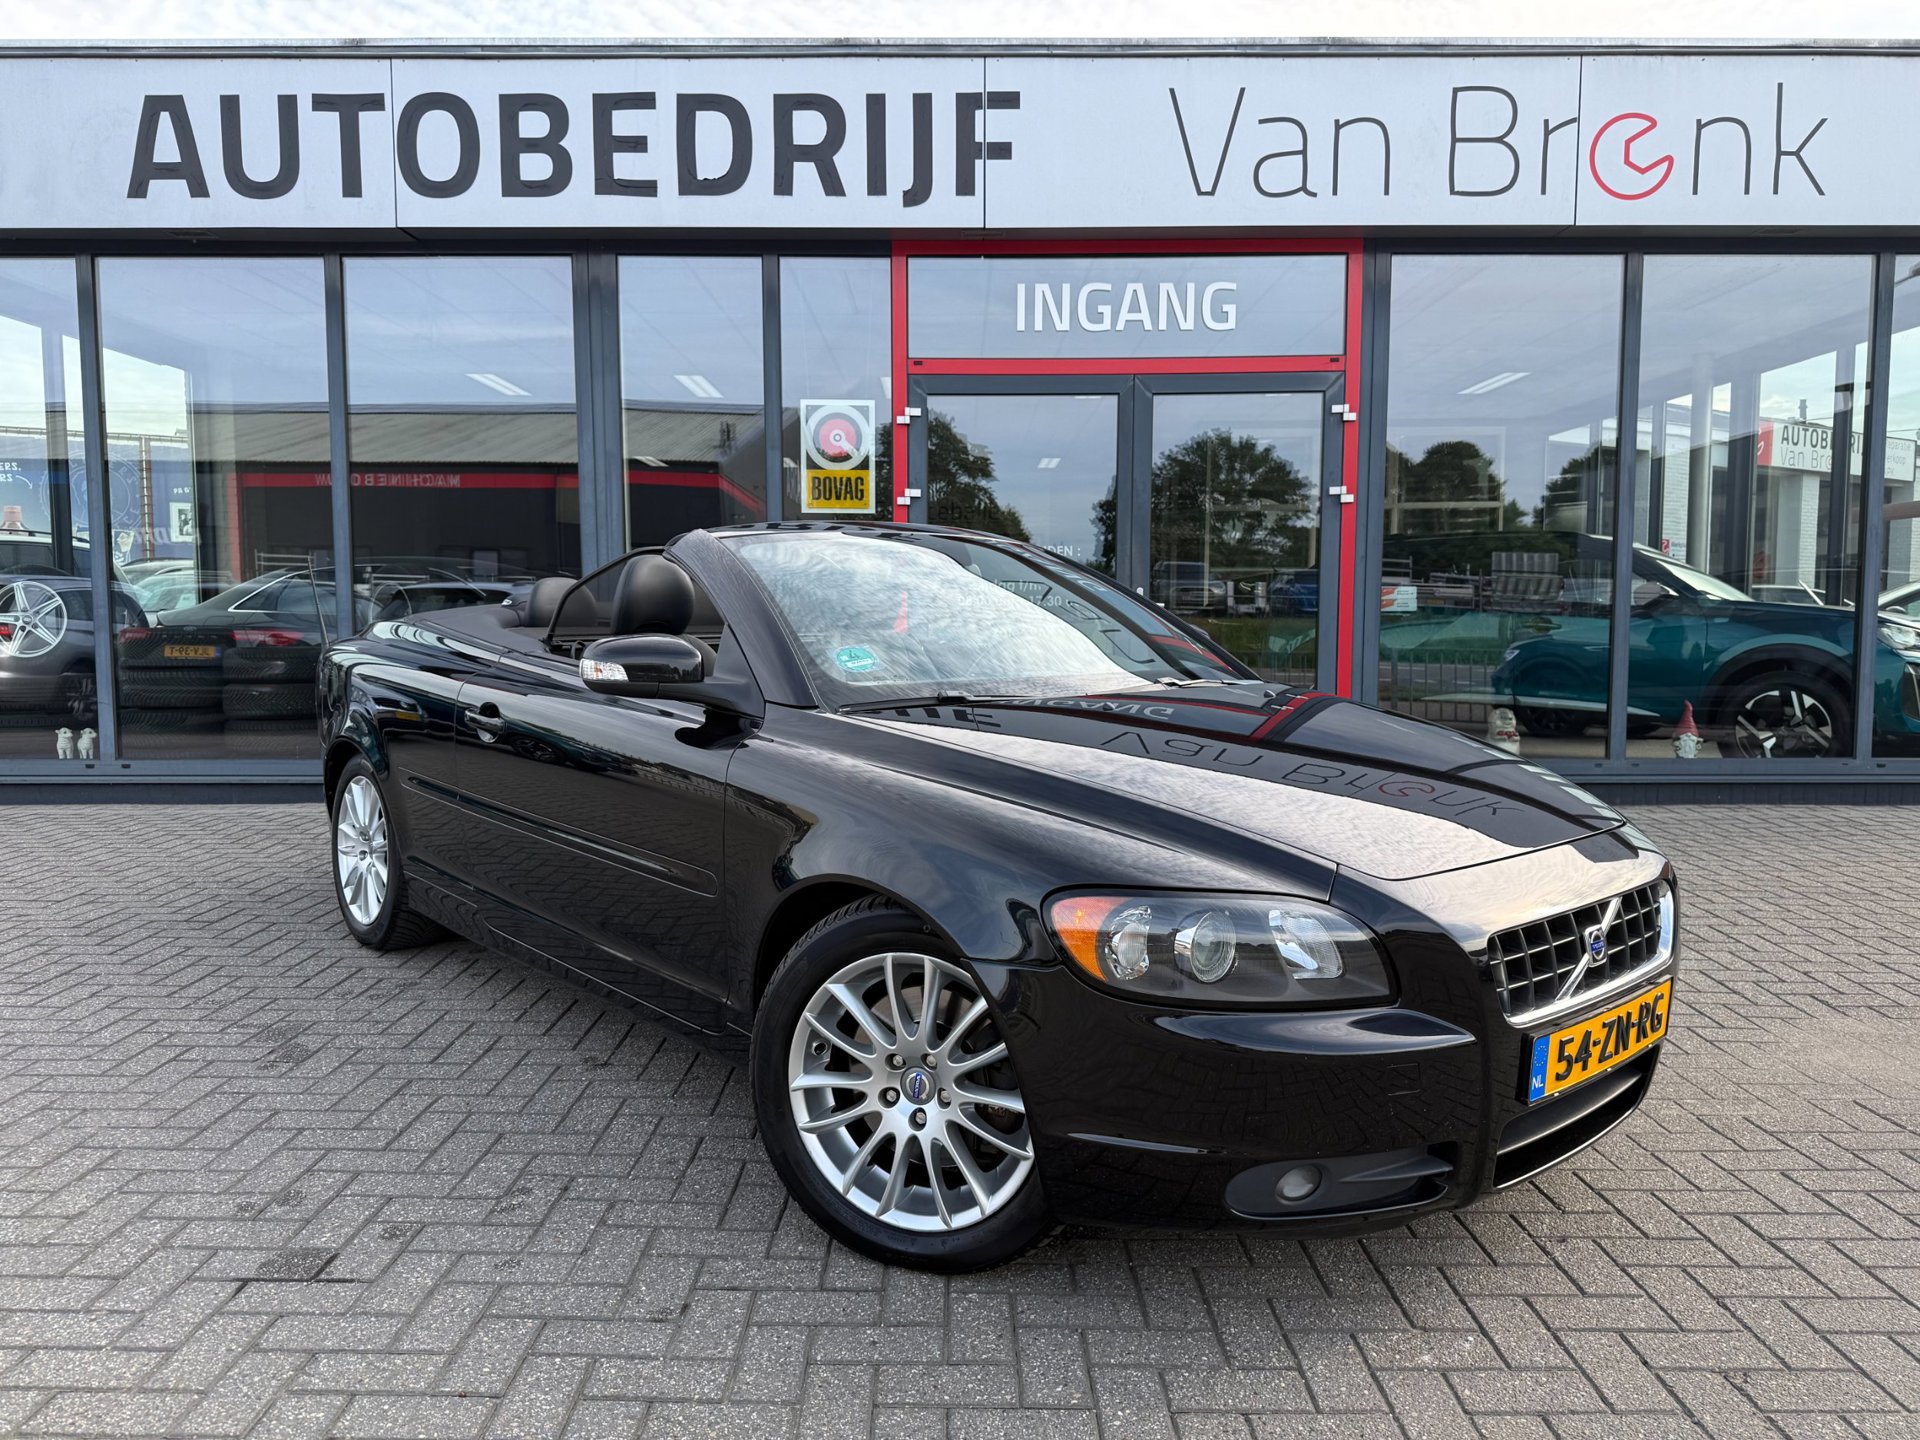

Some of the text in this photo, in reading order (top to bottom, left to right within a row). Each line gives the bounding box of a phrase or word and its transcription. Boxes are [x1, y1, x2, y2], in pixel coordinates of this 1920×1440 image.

[127, 92, 1021, 208] AUTOBEDRIJF
[1168, 86, 1391, 197] Van
[1016, 281, 1238, 333] INGANG
[811, 476, 865, 501] BOVAG
[1555, 992, 1665, 1082] 54-ZN-RG
[1531, 1074, 1544, 1090] NL
